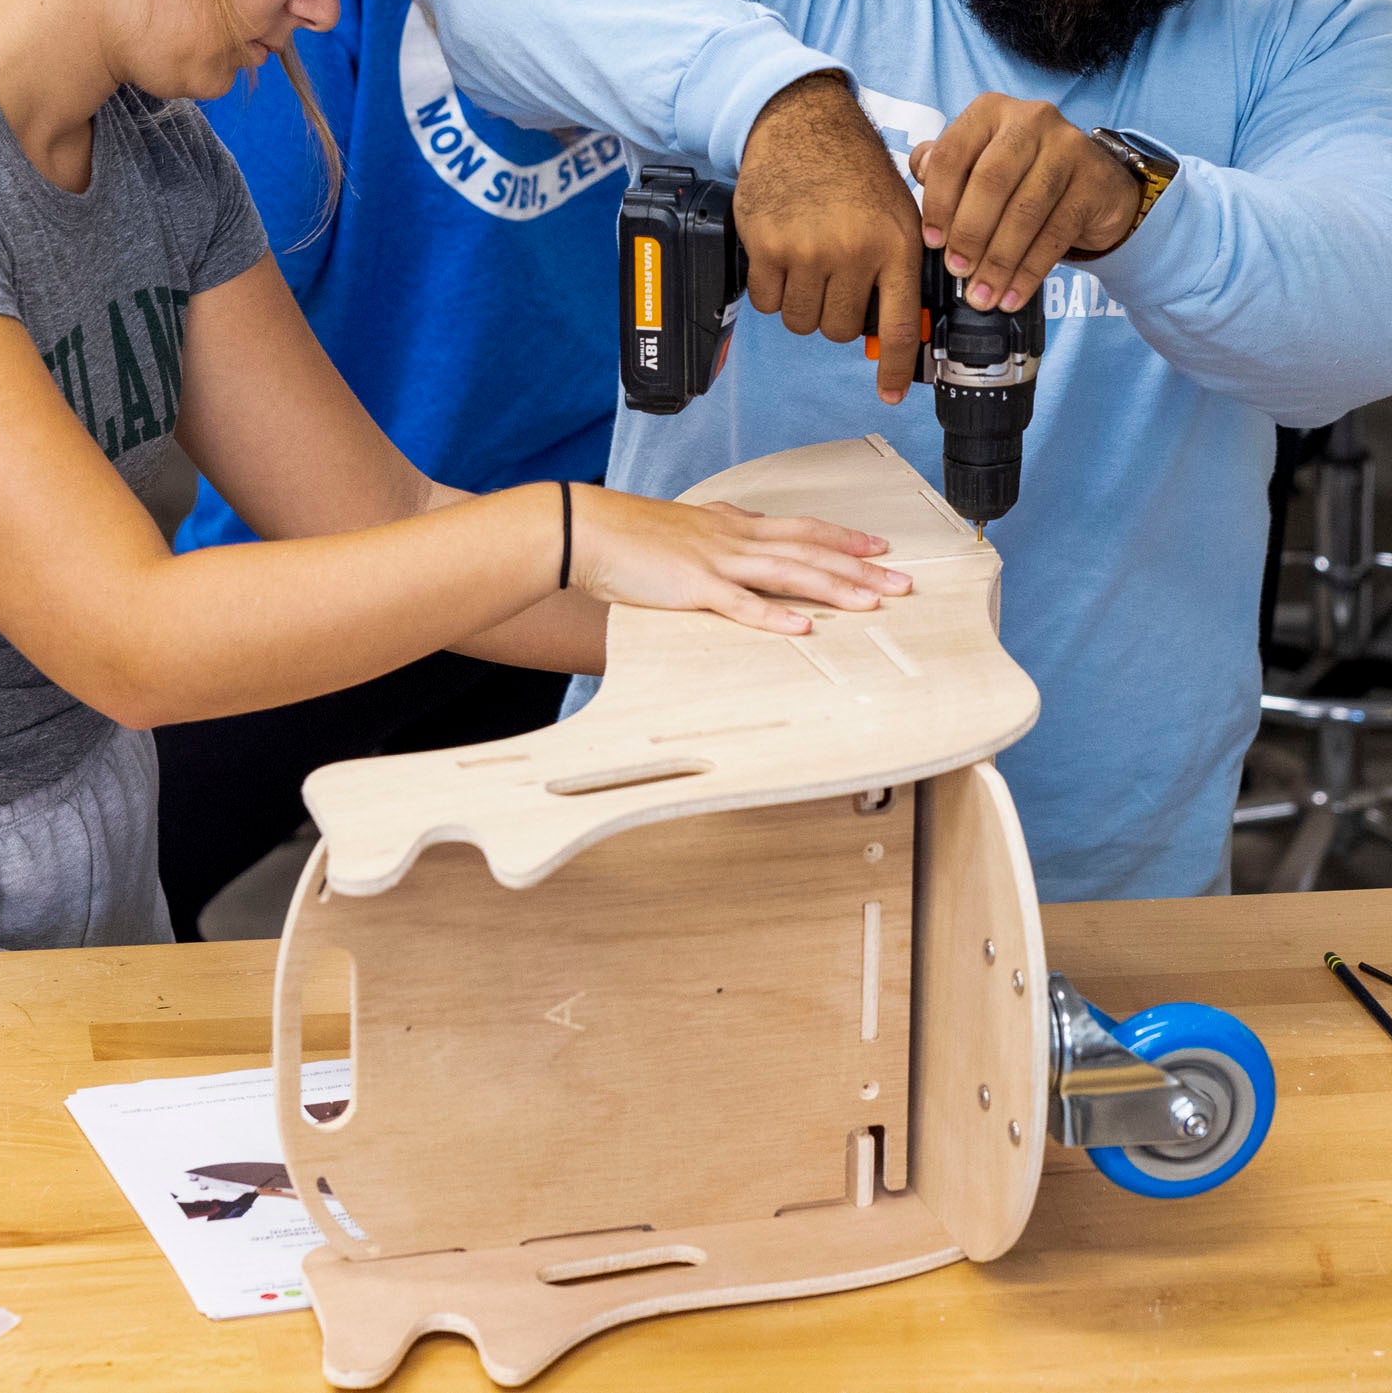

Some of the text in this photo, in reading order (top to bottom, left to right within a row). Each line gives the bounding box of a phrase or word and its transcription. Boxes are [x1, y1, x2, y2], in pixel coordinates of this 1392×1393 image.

[417, 96, 621, 209] NON SIBI, SED
[643, 242, 654, 322] WARRIOR
[645, 336, 658, 371] 18V
